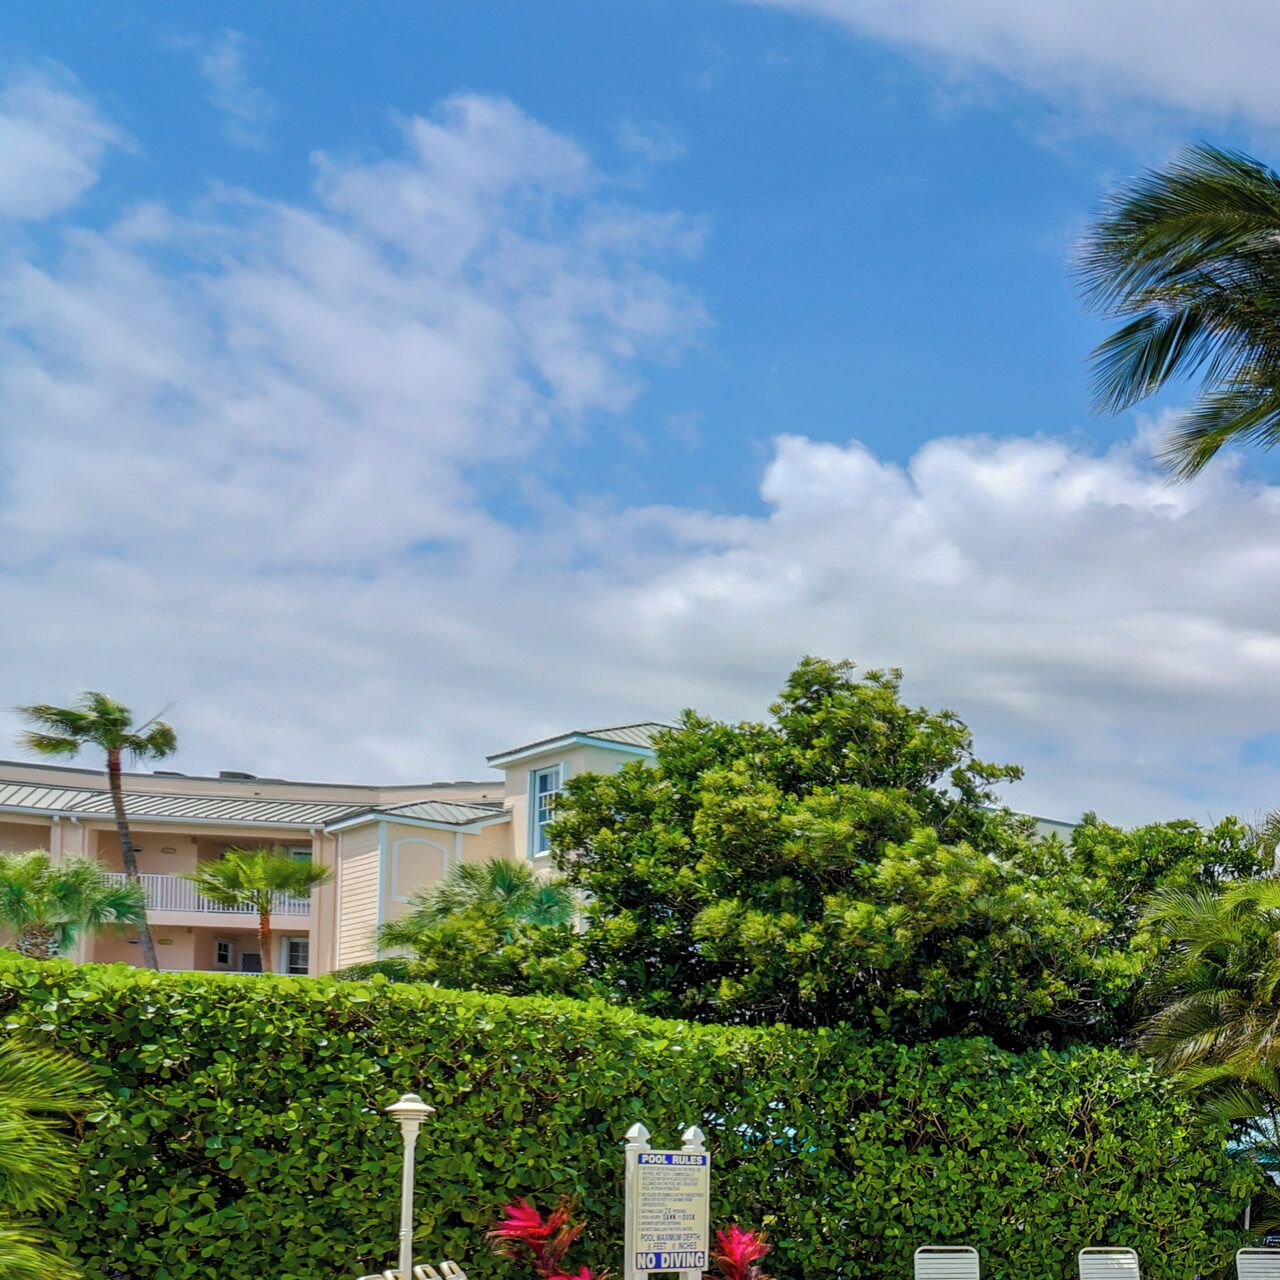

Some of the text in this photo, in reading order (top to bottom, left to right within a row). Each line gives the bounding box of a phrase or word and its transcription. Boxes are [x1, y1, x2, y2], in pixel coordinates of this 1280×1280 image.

[641, 1154, 703, 1165] POOL RULES
[640, 1233, 655, 1241] POOL
[656, 1233, 682, 1241] MAXIMUM
[653, 1242, 667, 1250] FEET
[678, 1241, 697, 1250] INCHES
[637, 1251, 704, 1268] NO DIVING
